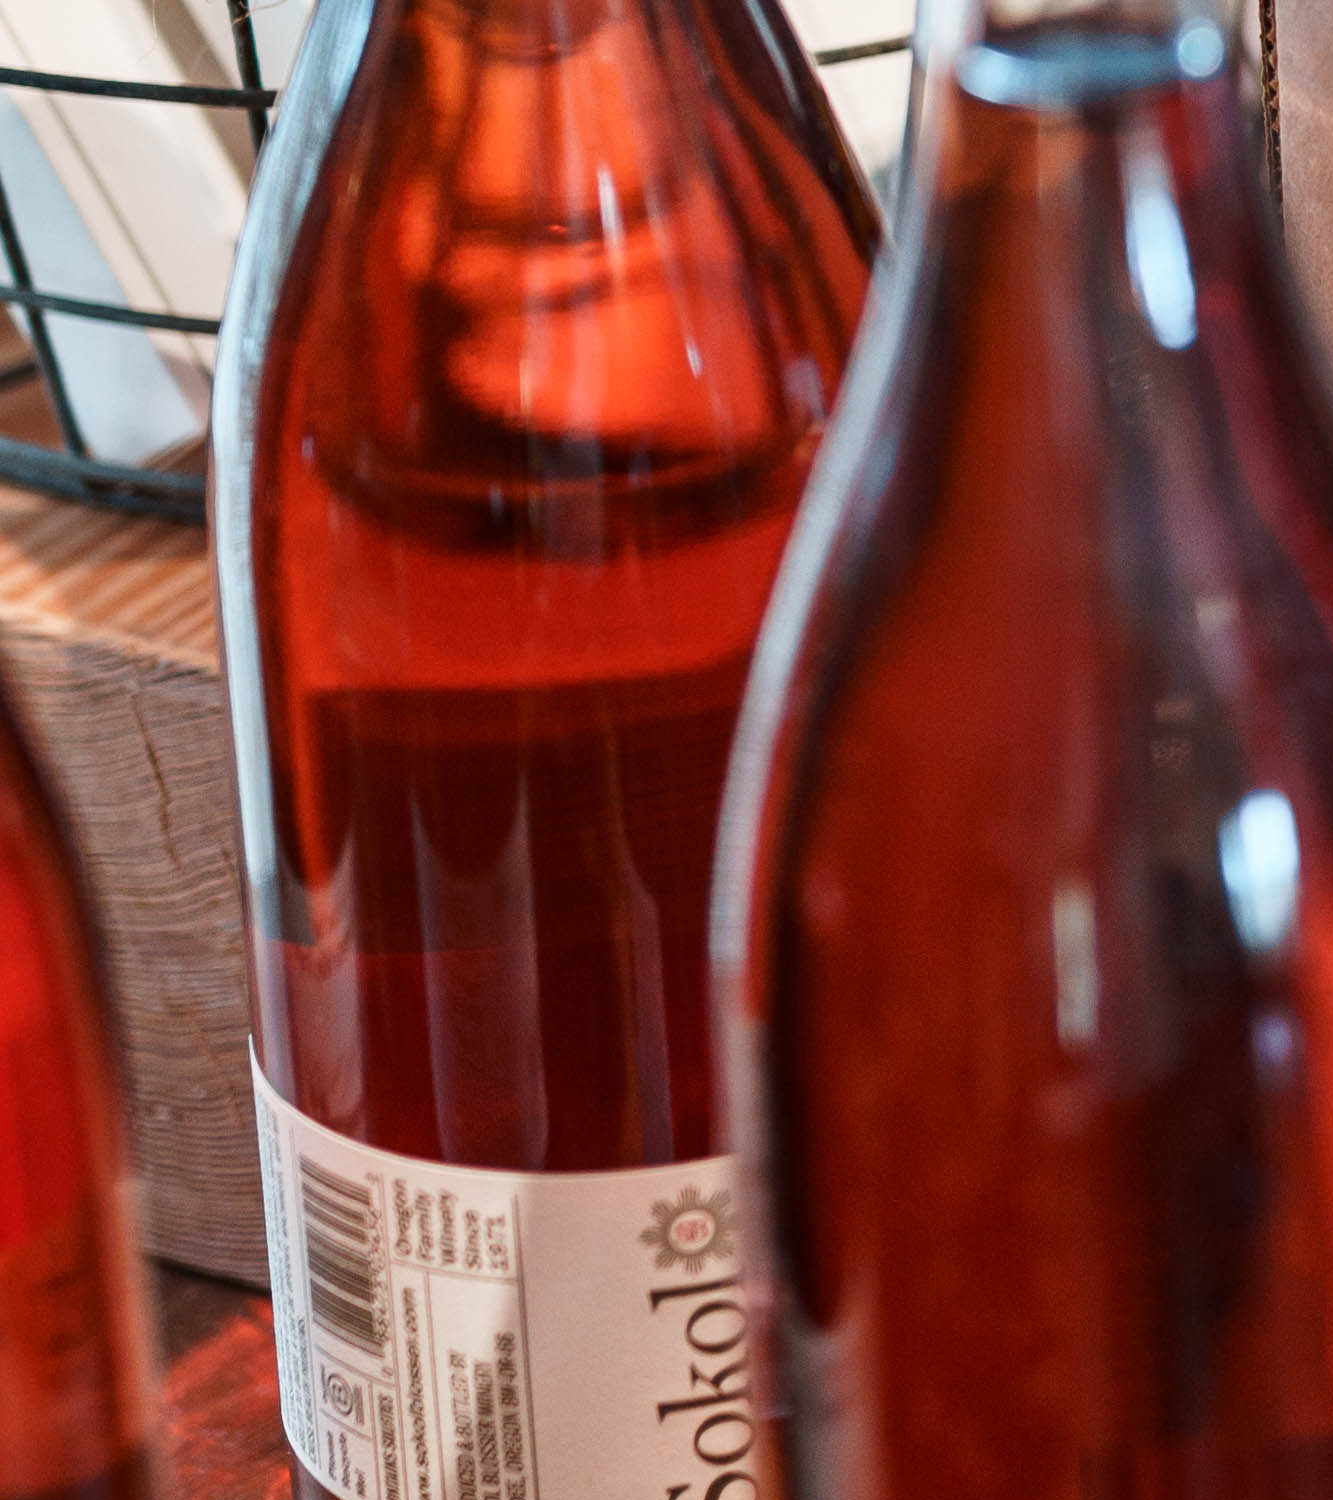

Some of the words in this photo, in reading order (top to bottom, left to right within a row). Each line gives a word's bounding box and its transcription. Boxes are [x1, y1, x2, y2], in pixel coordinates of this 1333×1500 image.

[392, 1178, 413, 1257] Oregon
[414, 1188, 435, 1262] Family
[438, 1187, 459, 1267] Winery
[463, 1208, 482, 1271] Since
[485, 1214, 509, 1271] 1971
[473, 1358, 494, 1417] WINERY
[477, 1419, 500, 1488] BLOSSER
[501, 1410, 526, 1474] OREGON
